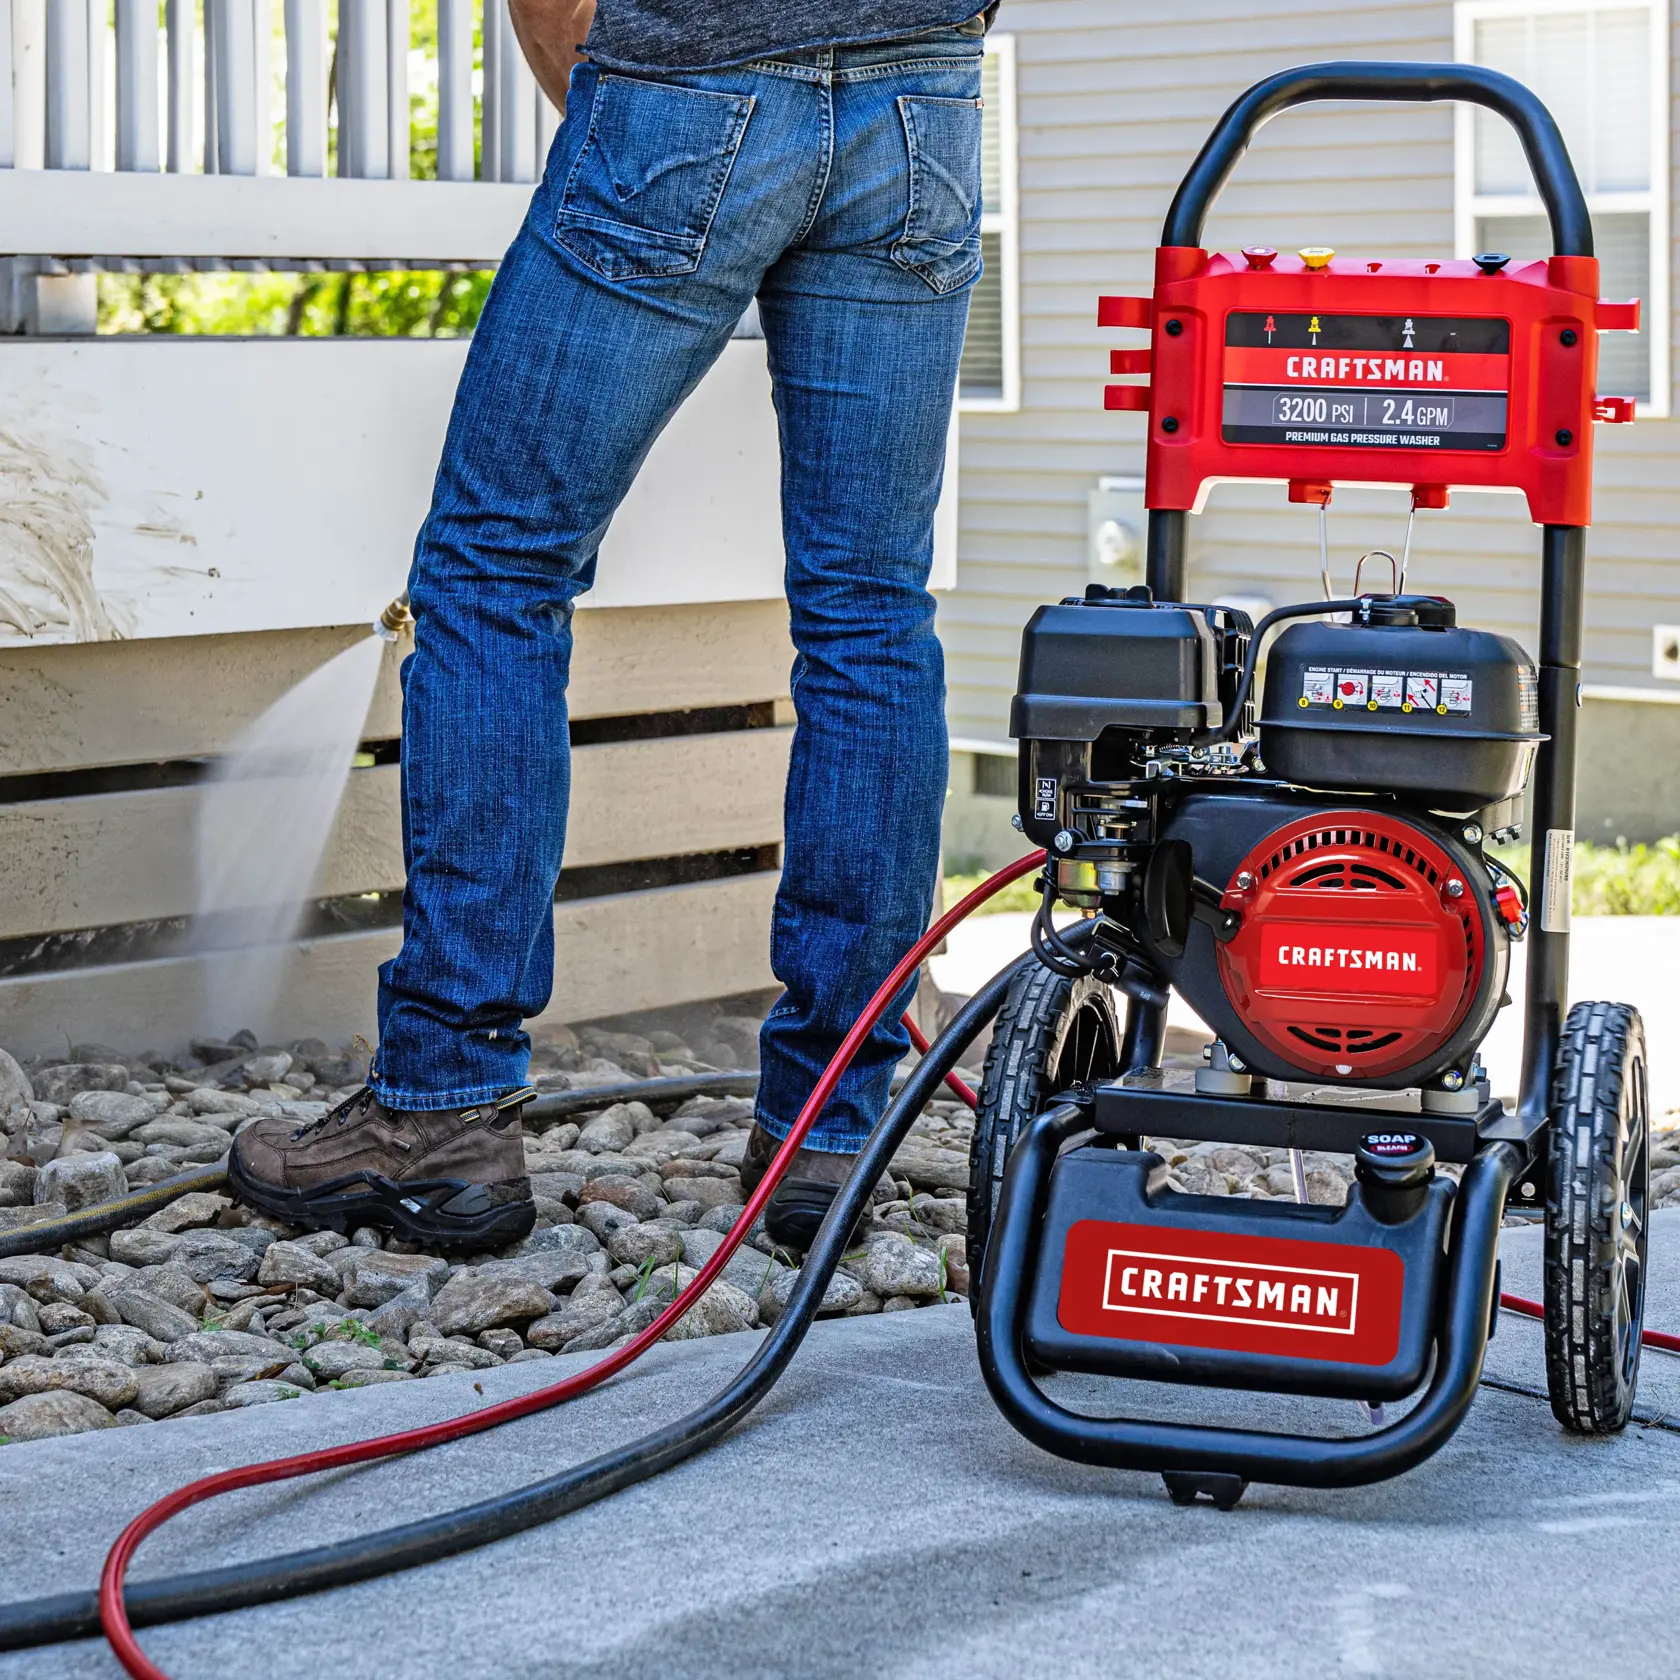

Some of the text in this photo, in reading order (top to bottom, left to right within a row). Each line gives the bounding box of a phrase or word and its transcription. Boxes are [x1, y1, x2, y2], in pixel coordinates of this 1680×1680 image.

[1286, 356, 1443, 382] CRAFTSMAN
[1278, 397, 1448, 426] 3200 PSI 2.4 GPM
[1285, 431, 1440, 446] PREMIUM GAS PRESSURE WASHER
[1346, 667, 1376, 675] DÉMARRAGE
[1278, 945, 1416, 972] CRAFTSMAN
[1367, 1134, 1416, 1144] SOAP
[1120, 1266, 1339, 1317] CRAFTSMAN
